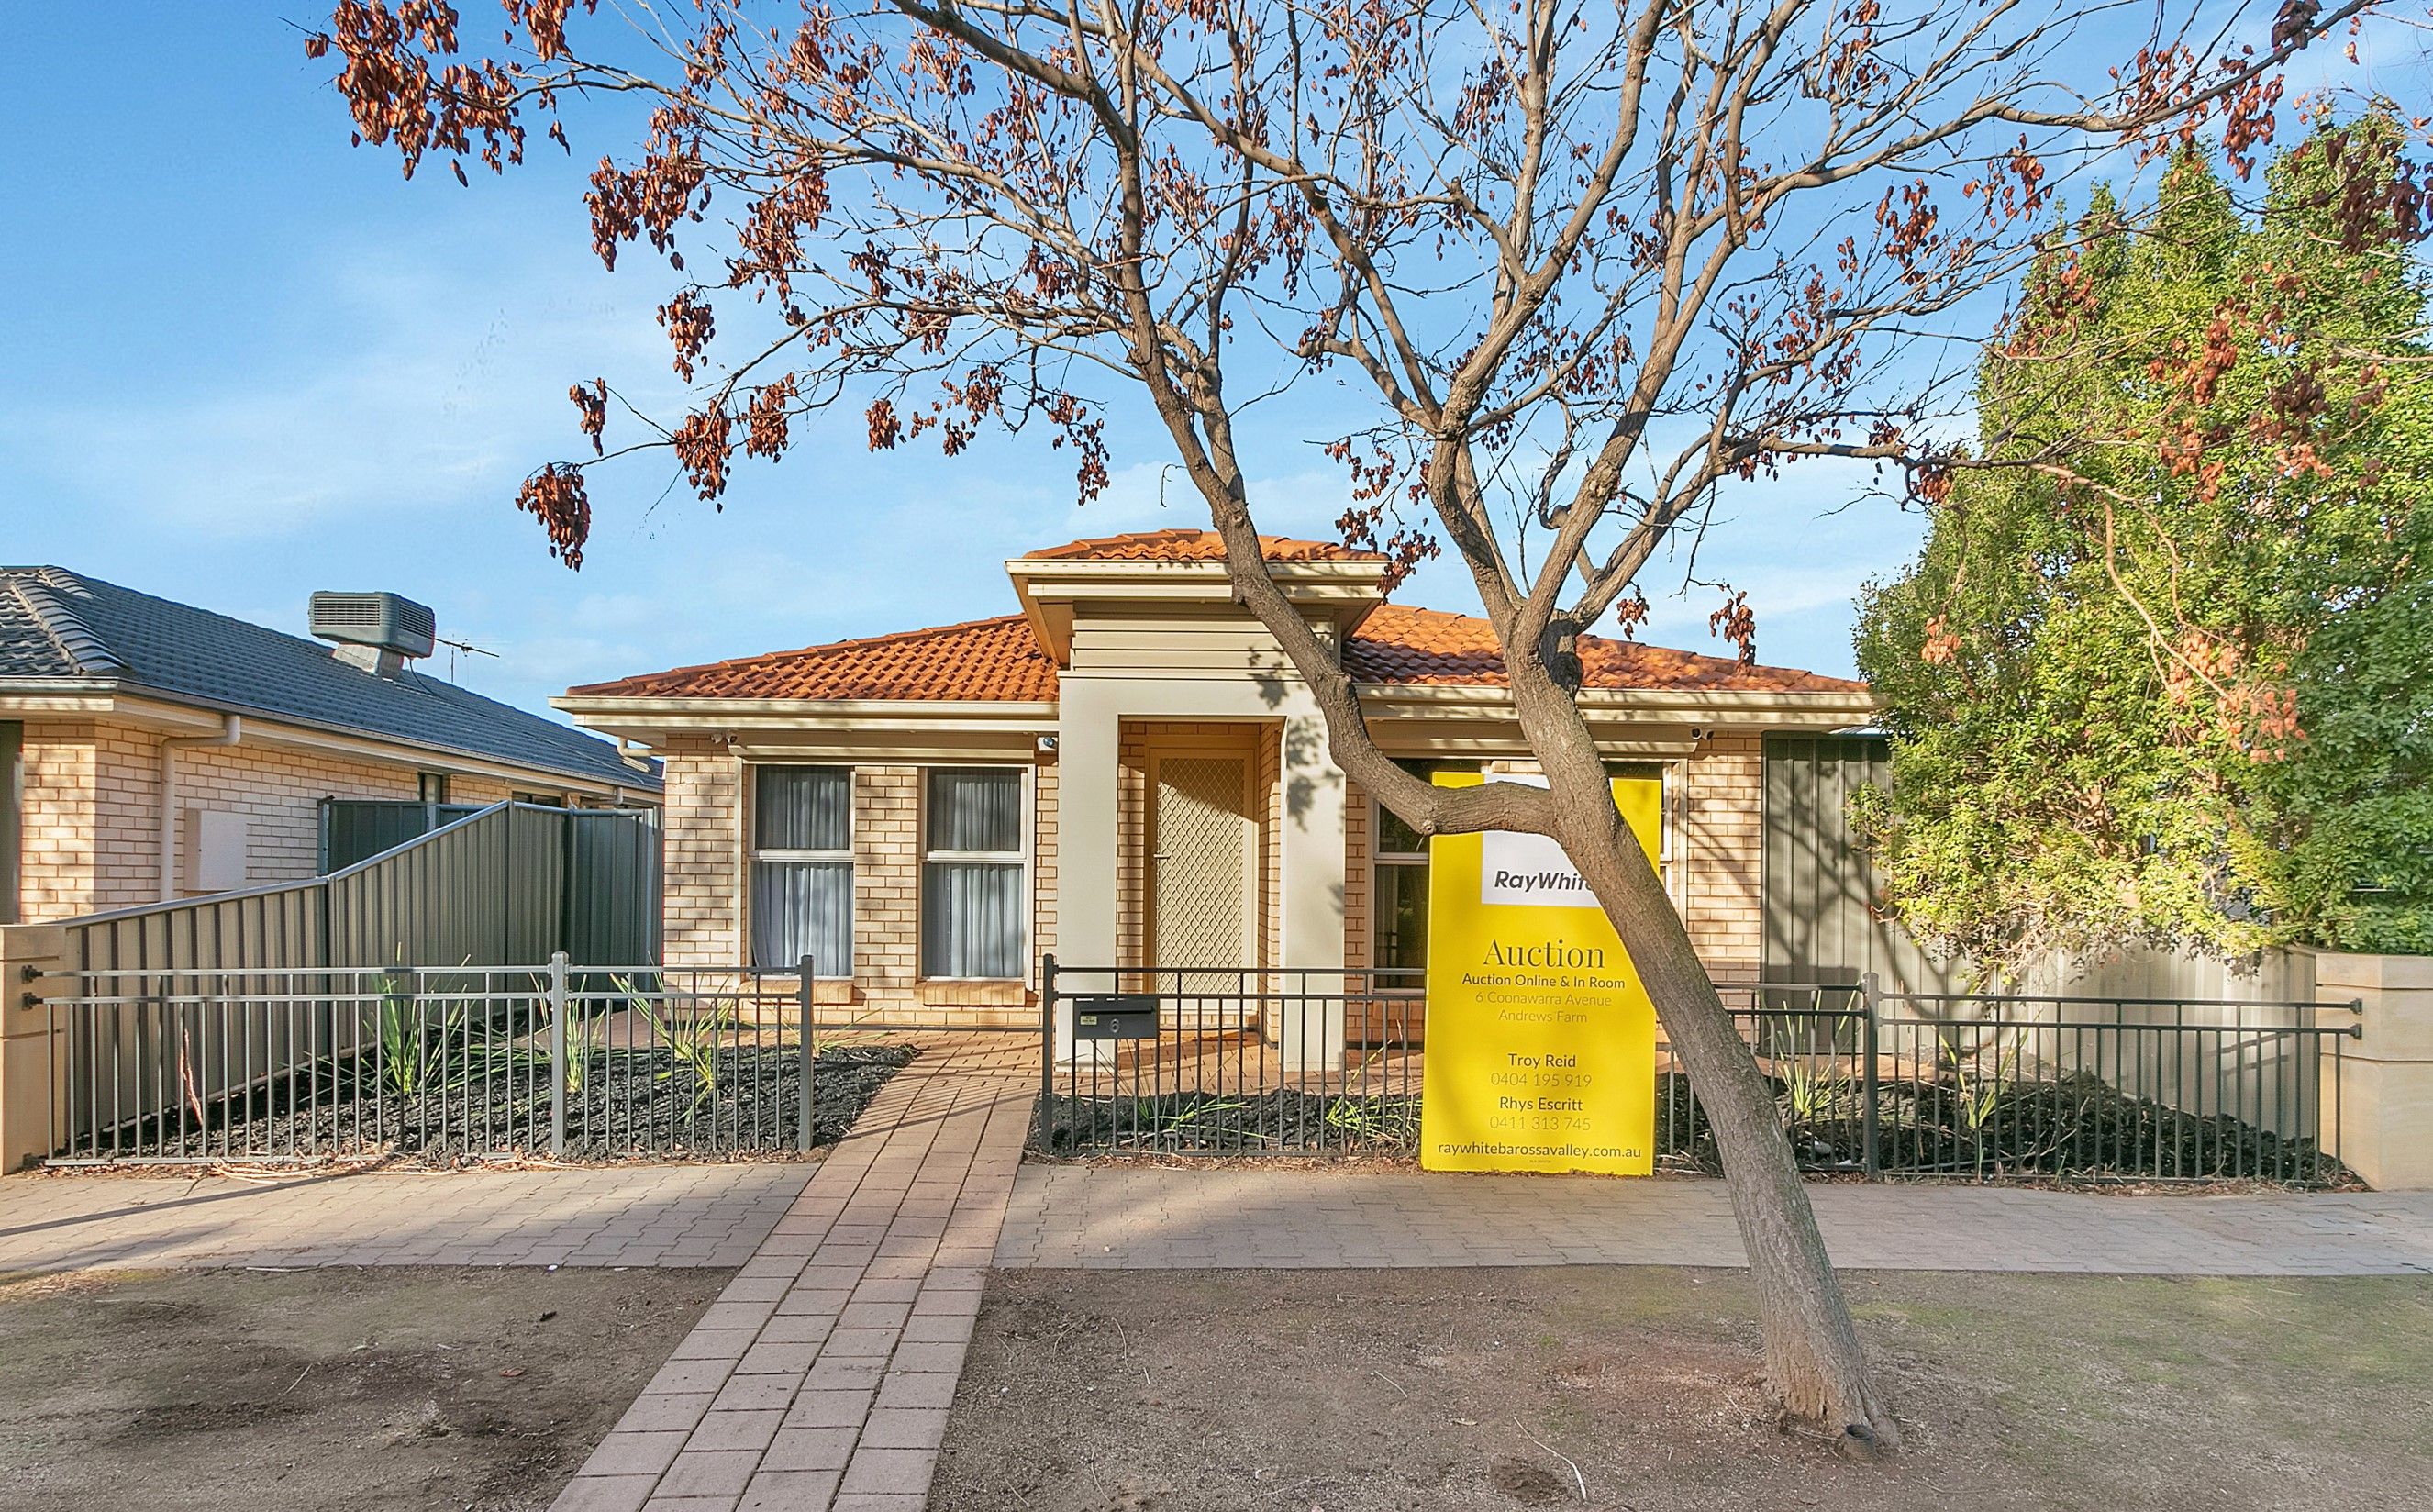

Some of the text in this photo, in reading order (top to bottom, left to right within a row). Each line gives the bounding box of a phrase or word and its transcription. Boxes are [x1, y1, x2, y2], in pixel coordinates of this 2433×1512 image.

[1483, 939, 1605, 969] Auction
[1462, 973, 1626, 989] Auction Online & In Room
[1475, 991, 1612, 1006] 6 Coonawarra Avenue
[1498, 1009, 1587, 1023] Andrews Farm
[1110, 1018, 1120, 1033] 6
[1508, 1053, 1576, 1069] Troy Reid
[1491, 1072, 1592, 1088] 0404 195 919
[1500, 1096, 1583, 1112] Rhys Escritt
[1489, 1116, 1591, 1131] 0411 313 745
[1438, 1141, 1641, 1159] raywhitebarossavalley.com.au
